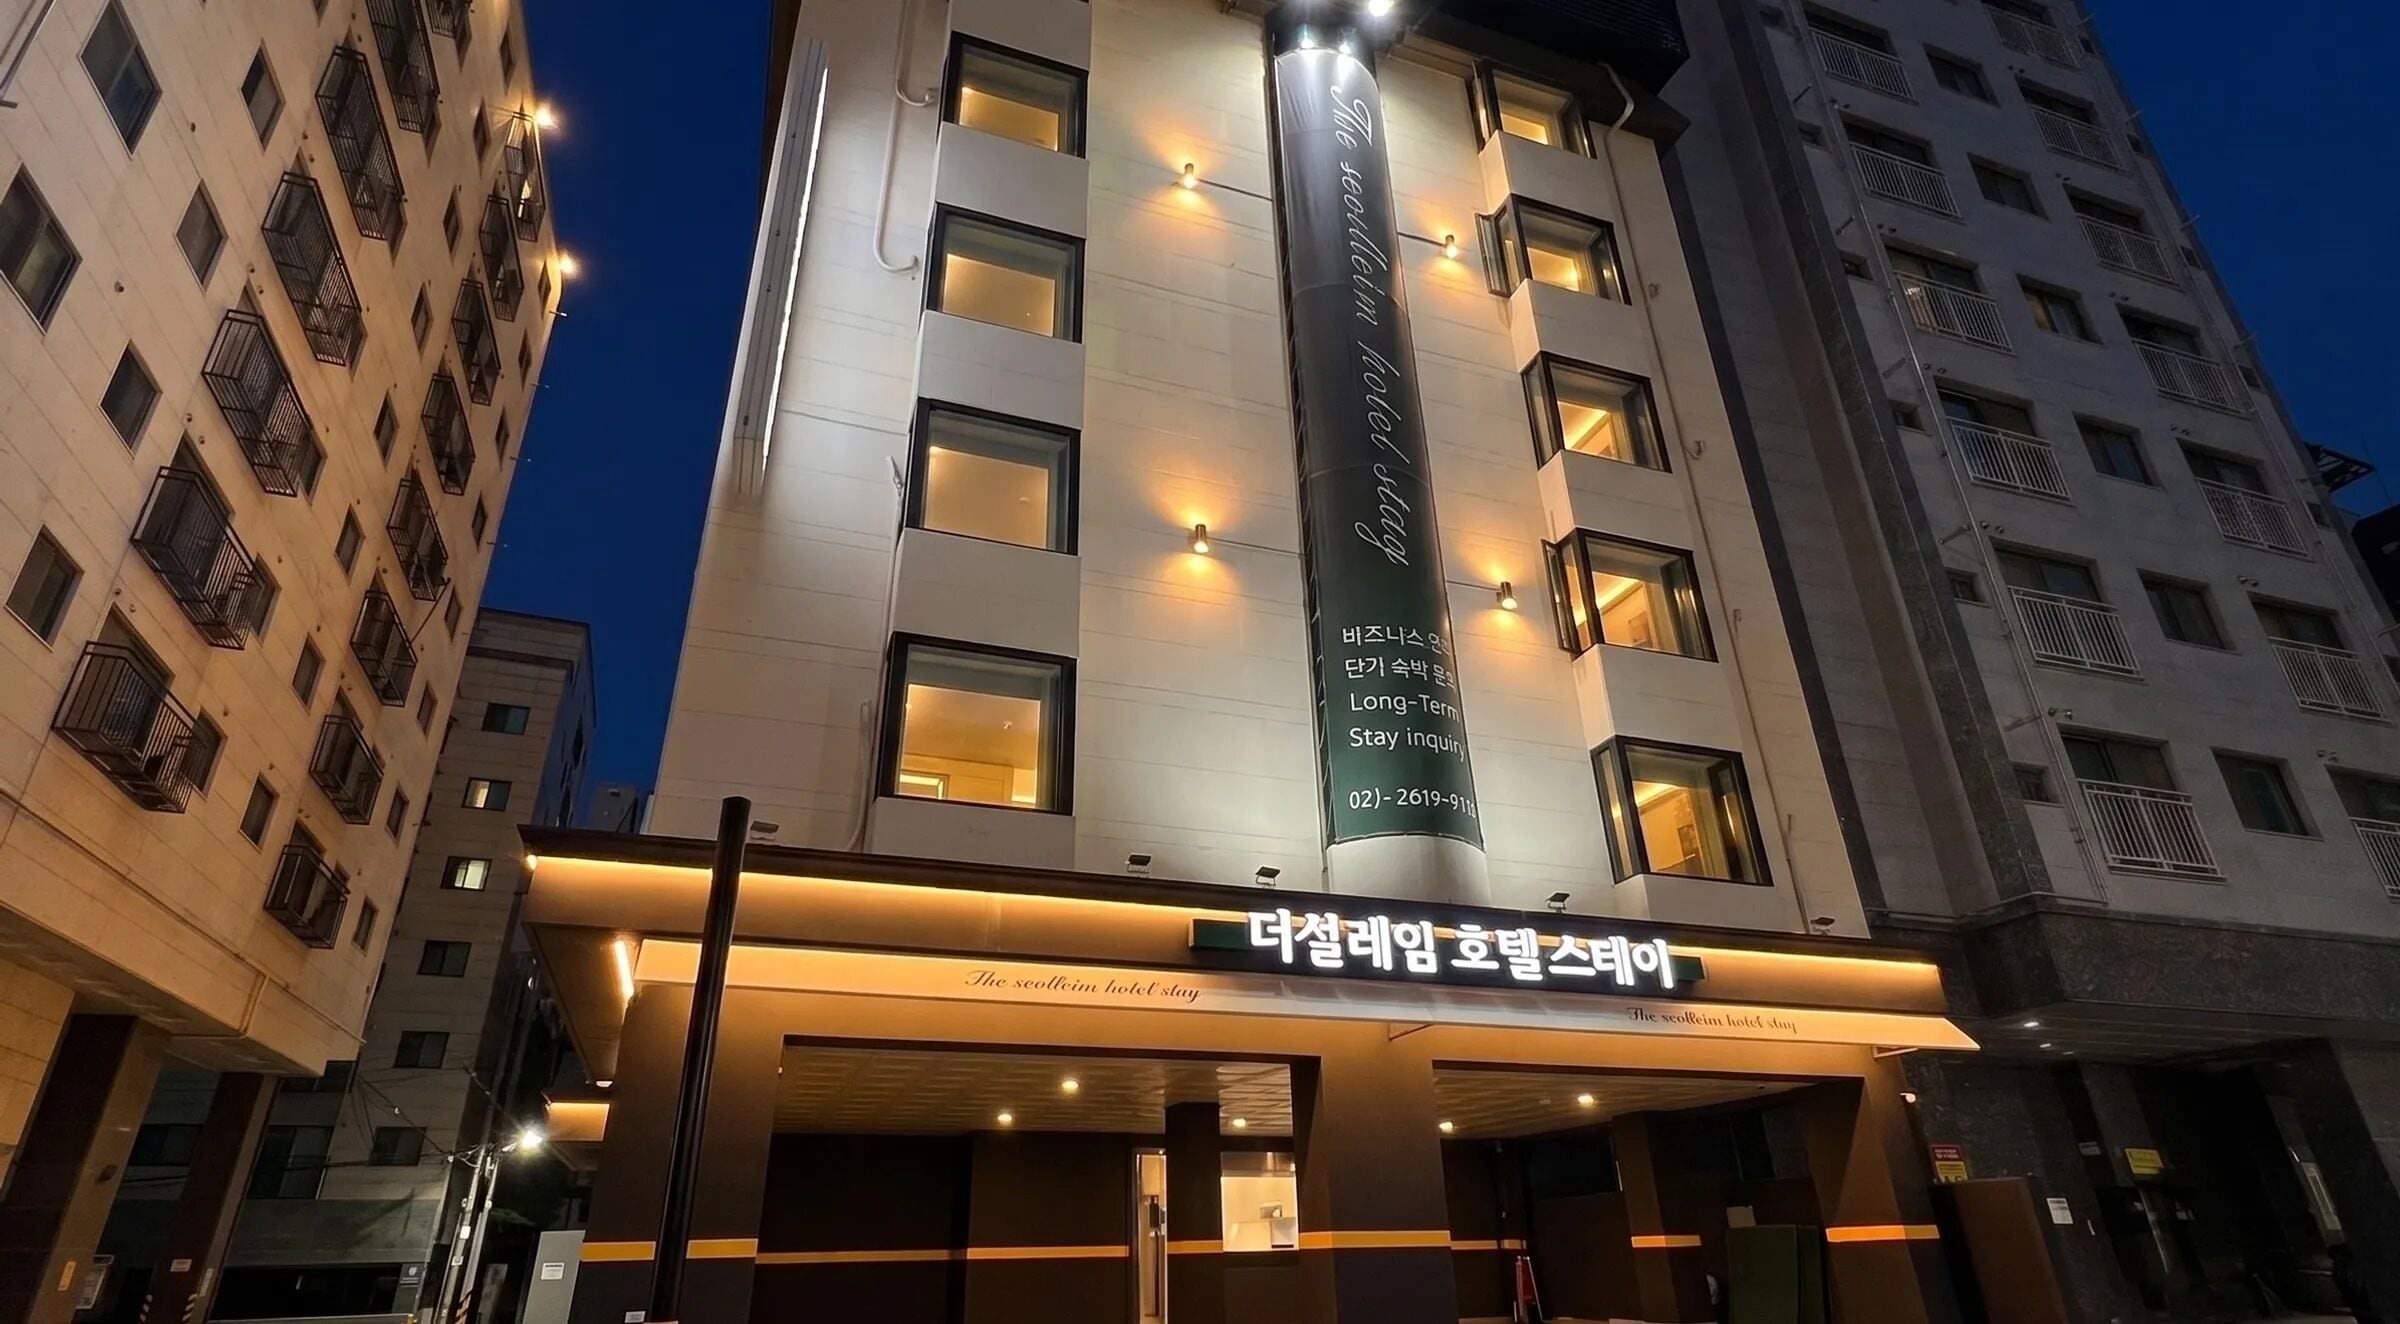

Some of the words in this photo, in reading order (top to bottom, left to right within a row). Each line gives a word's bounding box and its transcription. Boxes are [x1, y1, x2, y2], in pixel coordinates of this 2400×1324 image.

[1330, 85, 1372, 149] The
[1357, 340, 1401, 464] hotel
[1342, 625, 1425, 646] 비즈니스
[1345, 656, 1385, 679] 단기
[1391, 657, 1428, 681] 숙박
[1350, 692, 1460, 722] Long-Term
[1349, 727, 1399, 751] Stay
[1406, 727, 1465, 763] inquiry
[1248, 908, 1438, 973] 더설레임
[1450, 924, 1544, 981] 호텔
[1547, 933, 1675, 990] 스테이
[965, 970, 1008, 988] The
[1104, 979, 1159, 996] hotel
[1160, 984, 1201, 1003] stay
[1627, 1007, 1657, 1022] The
[1726, 1014, 1764, 1029] hotel
[1766, 1017, 1797, 1034] stay
